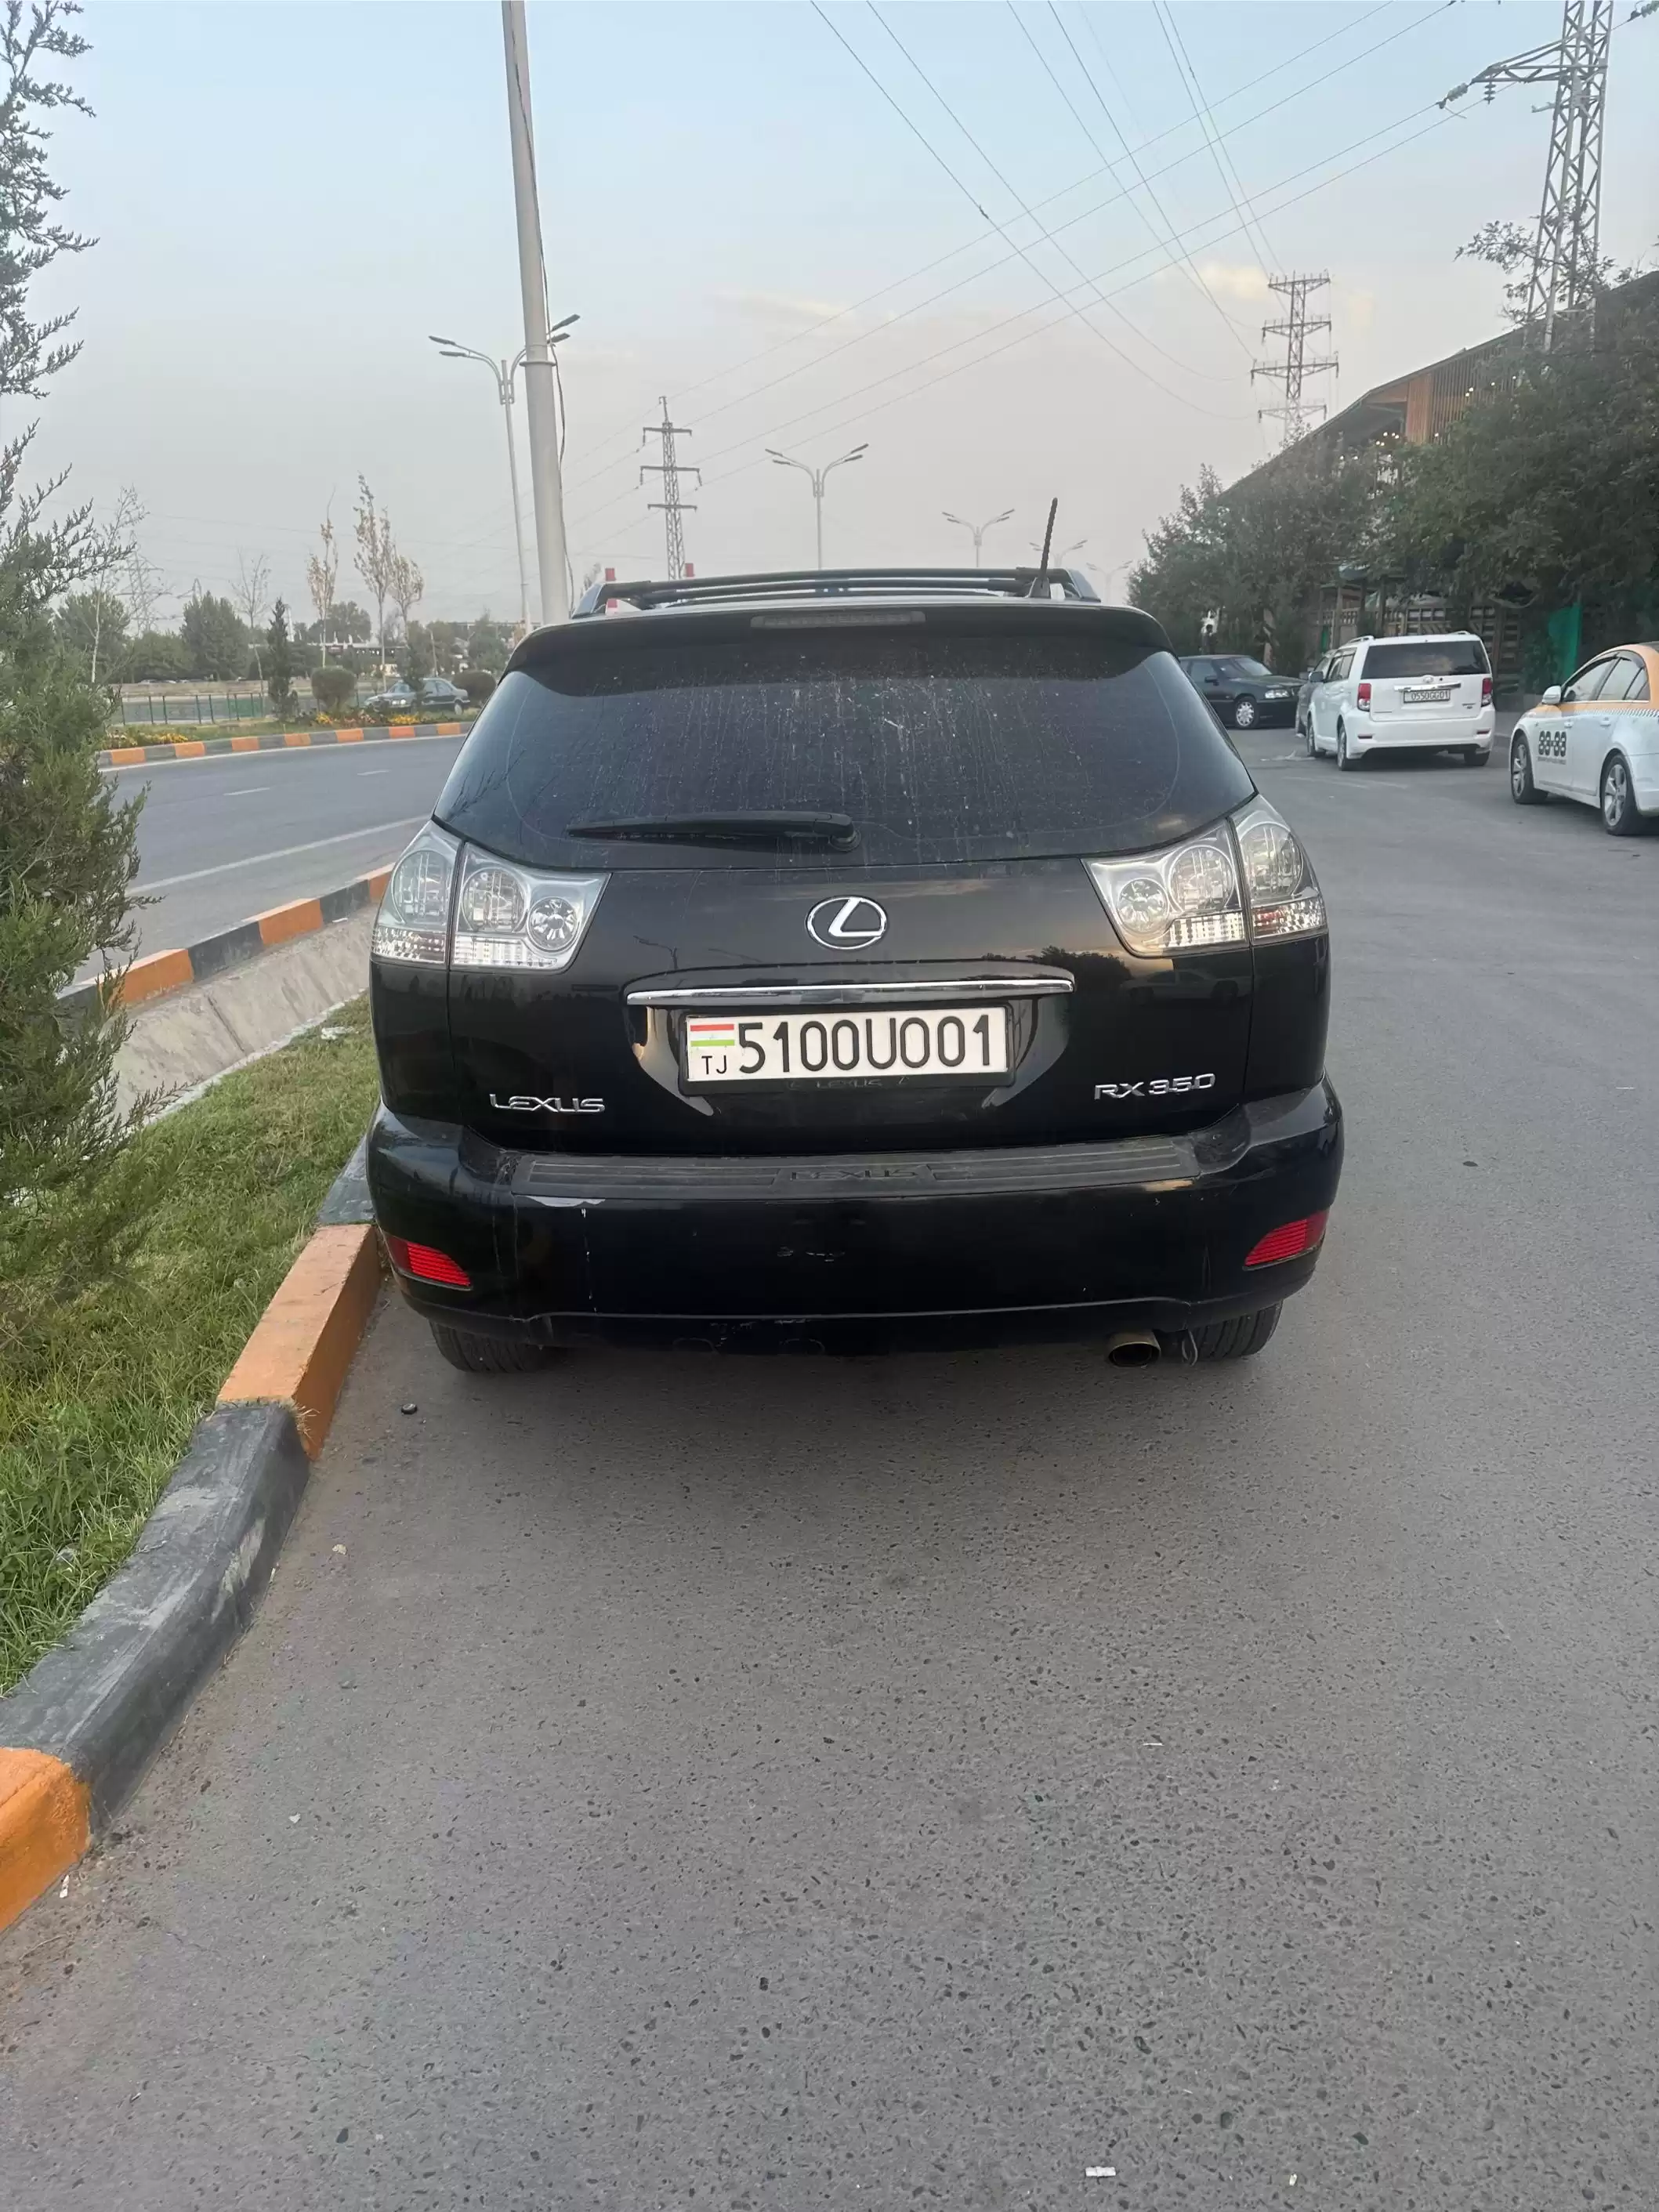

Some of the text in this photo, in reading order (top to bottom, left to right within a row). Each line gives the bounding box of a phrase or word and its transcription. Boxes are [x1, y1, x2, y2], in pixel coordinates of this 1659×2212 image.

[701, 1055, 727, 1075] TJ
[1094, 1073, 1215, 1100] RX 350
[489, 1093, 606, 1113] LEXUS
